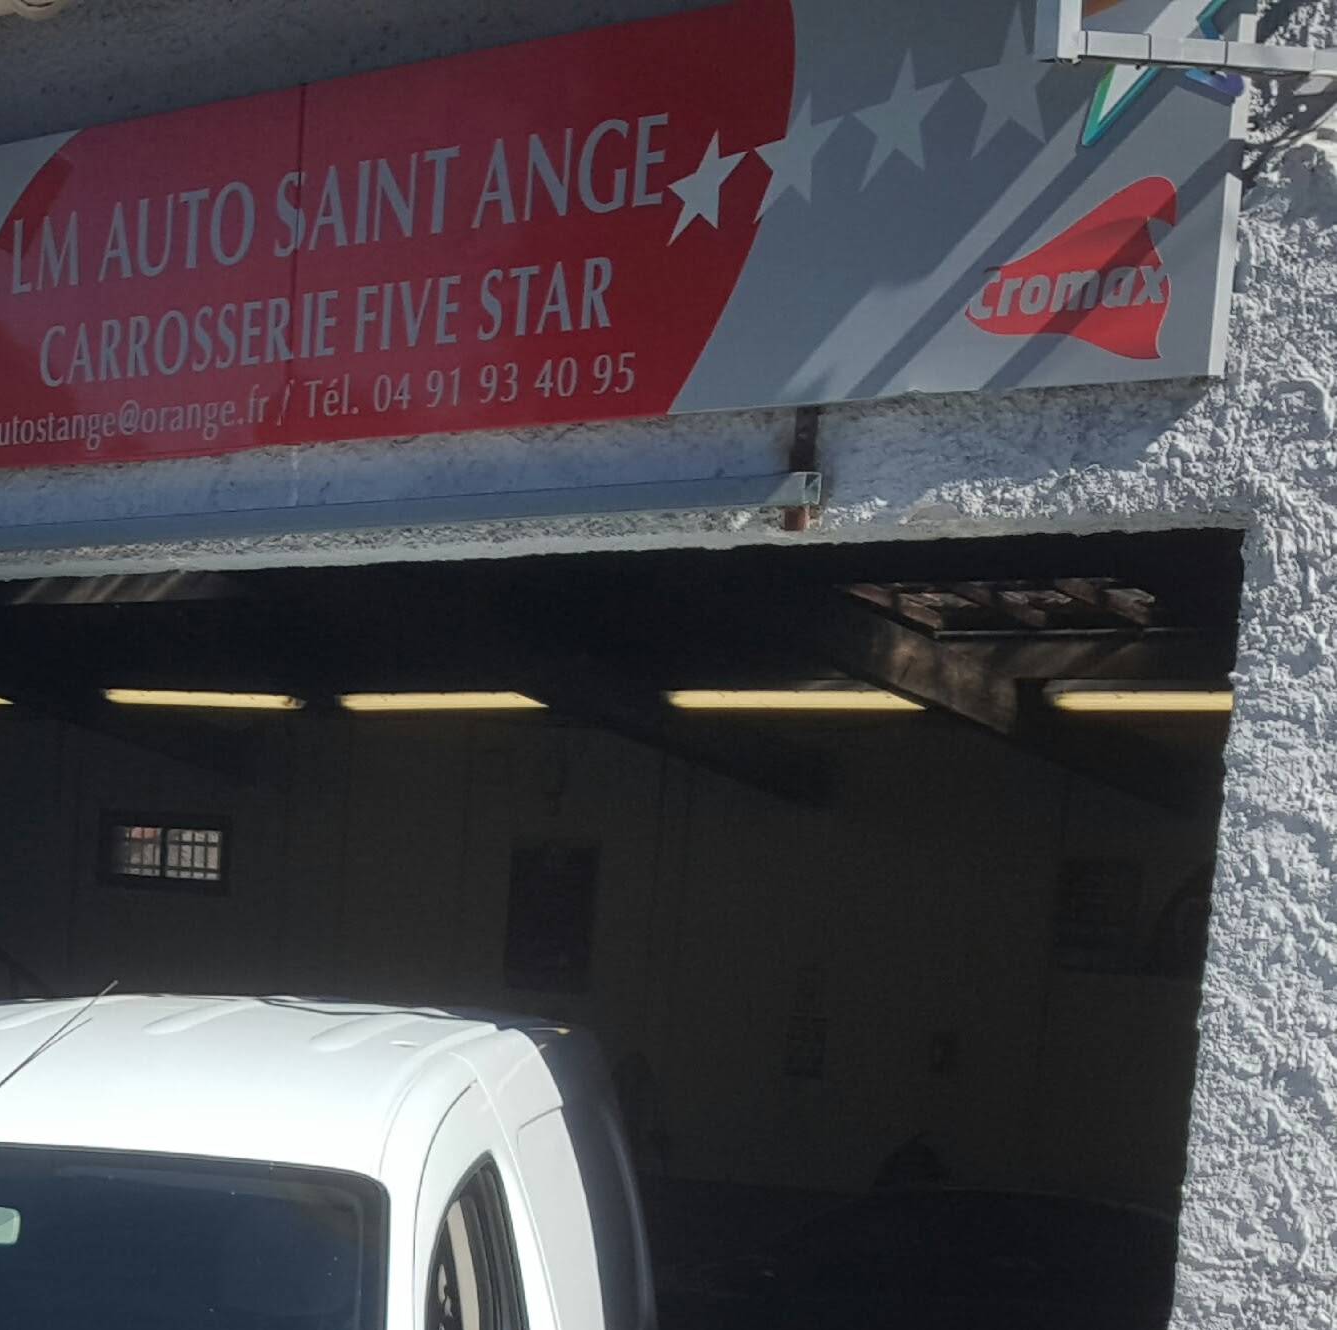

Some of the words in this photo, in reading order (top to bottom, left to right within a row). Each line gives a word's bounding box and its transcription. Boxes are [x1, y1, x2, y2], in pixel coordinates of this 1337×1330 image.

[11, 210, 79, 294] LM
[97, 180, 255, 282] AUTO
[274, 144, 460, 257] SAINT
[471, 112, 669, 228] ANGE
[39, 289, 338, 387] CARROSSERIE
[354, 273, 461, 354] FIVE
[477, 256, 613, 341] STAR
[968, 265, 1168, 320] Cromax
[304, 373, 360, 419] Tél.
[372, 372, 412, 413] 04
[426, 366, 462, 407] 91
[480, 362, 519, 405] 93
[534, 356, 578, 398] 40
[592, 352, 637, 395] 95
